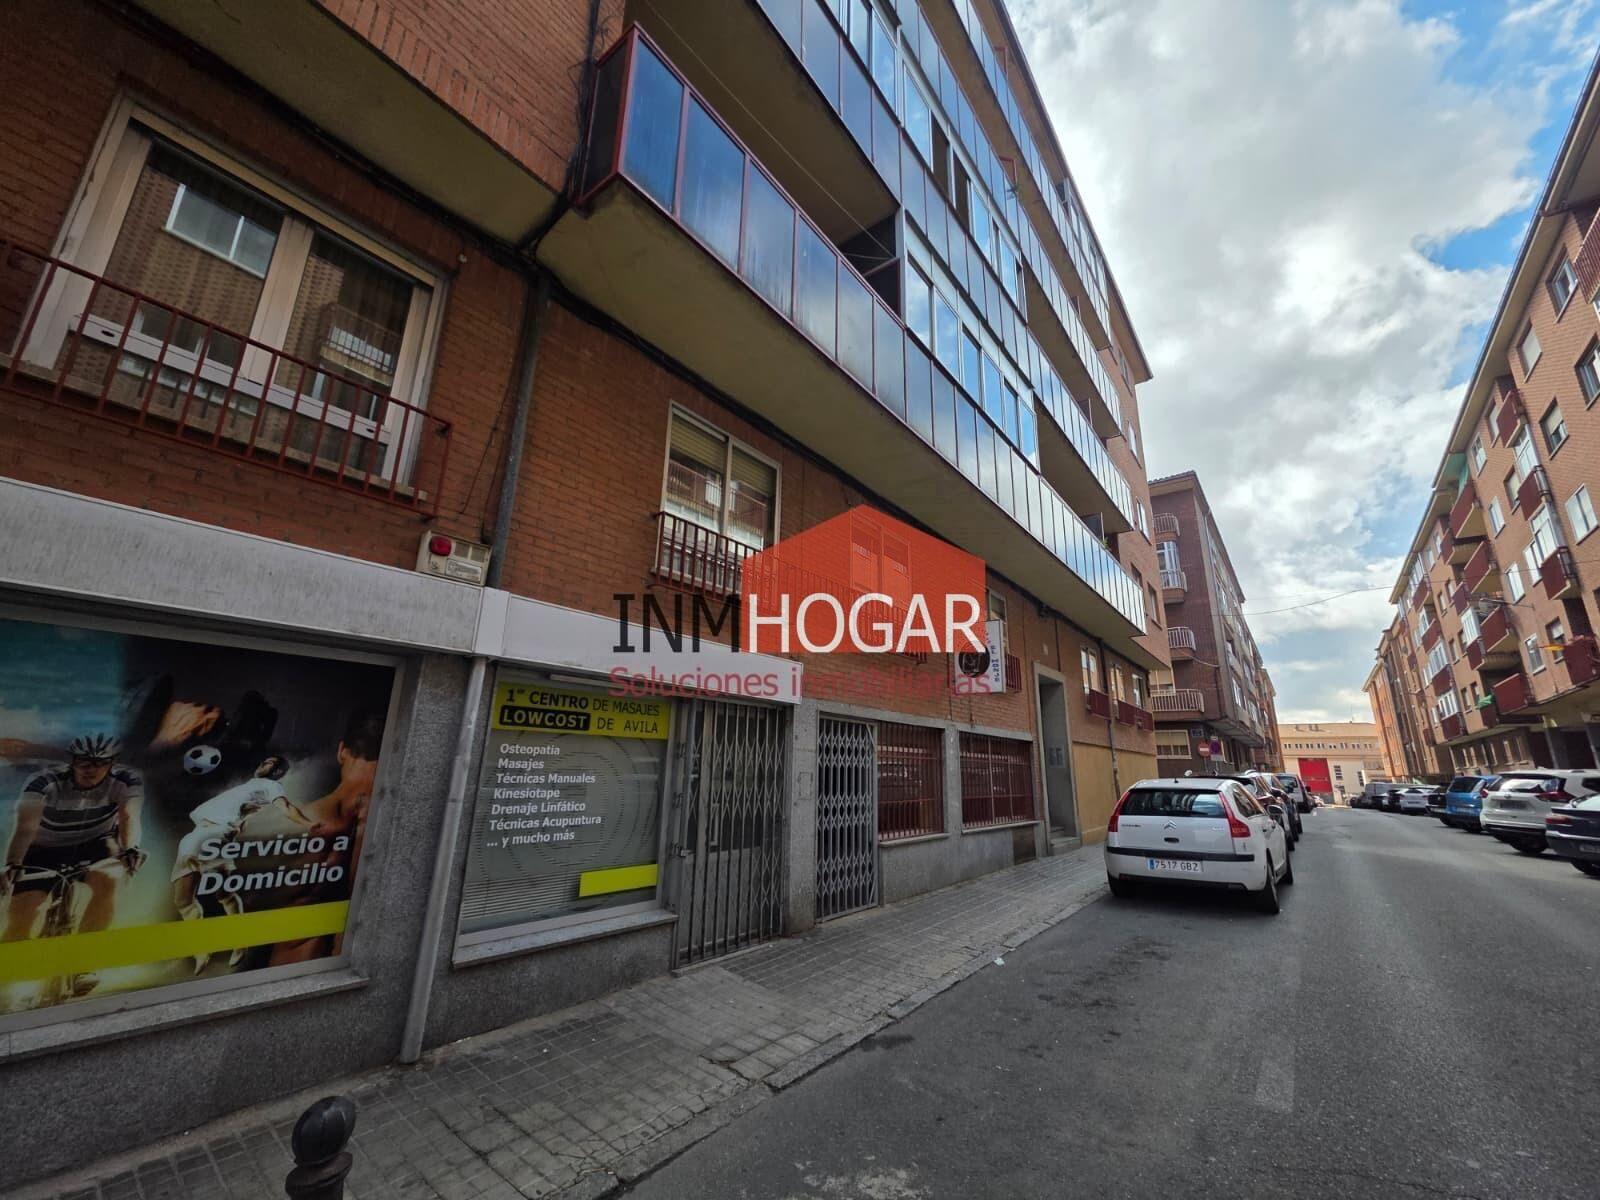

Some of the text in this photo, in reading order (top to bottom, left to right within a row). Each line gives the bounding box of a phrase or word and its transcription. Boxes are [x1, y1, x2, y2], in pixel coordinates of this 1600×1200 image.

[528, 690, 589, 710] CENTRO
[592, 699, 609, 712] DE
[612, 701, 660, 716] MASAJES
[502, 708, 659, 734] LOWCOST DE AVILA
[497, 758, 545, 771] Masajes
[495, 772, 596, 784] Técnicas Manuales
[493, 787, 561, 800] Kinesiotape
[491, 800, 586, 816] Drenaje Linfático
[489, 814, 602, 831] Técnicas Acupuntura
[502, 836, 509, 848] y
[512, 831, 551, 845] mucho
[553, 828, 575, 841] más
[198, 833, 350, 861] Servicio a
[1155, 860, 1178, 870] 7517
[196, 862, 344, 896] Domicilio
